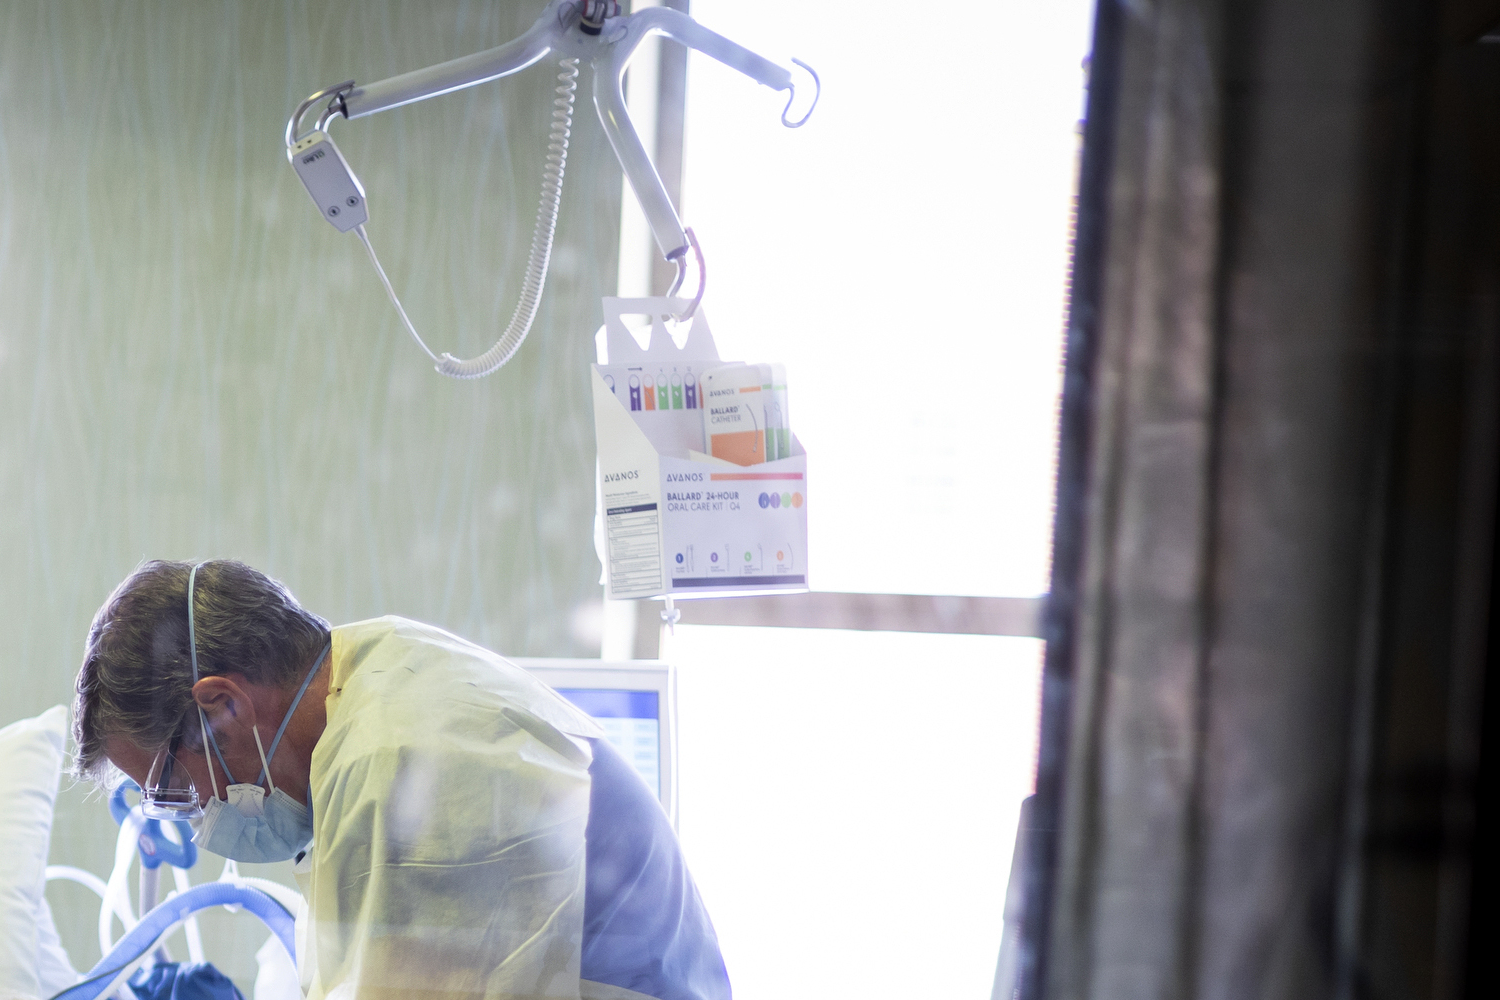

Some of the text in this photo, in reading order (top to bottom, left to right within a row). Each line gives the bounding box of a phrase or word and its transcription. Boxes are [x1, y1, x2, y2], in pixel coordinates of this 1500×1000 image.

[604, 470, 640, 483] AVANOS
[666, 473, 704, 482] AVANOS
[666, 491, 740, 501] BALLARD 24-HOUR
[667, 501, 741, 512] ORAL CARE KIT Q4
